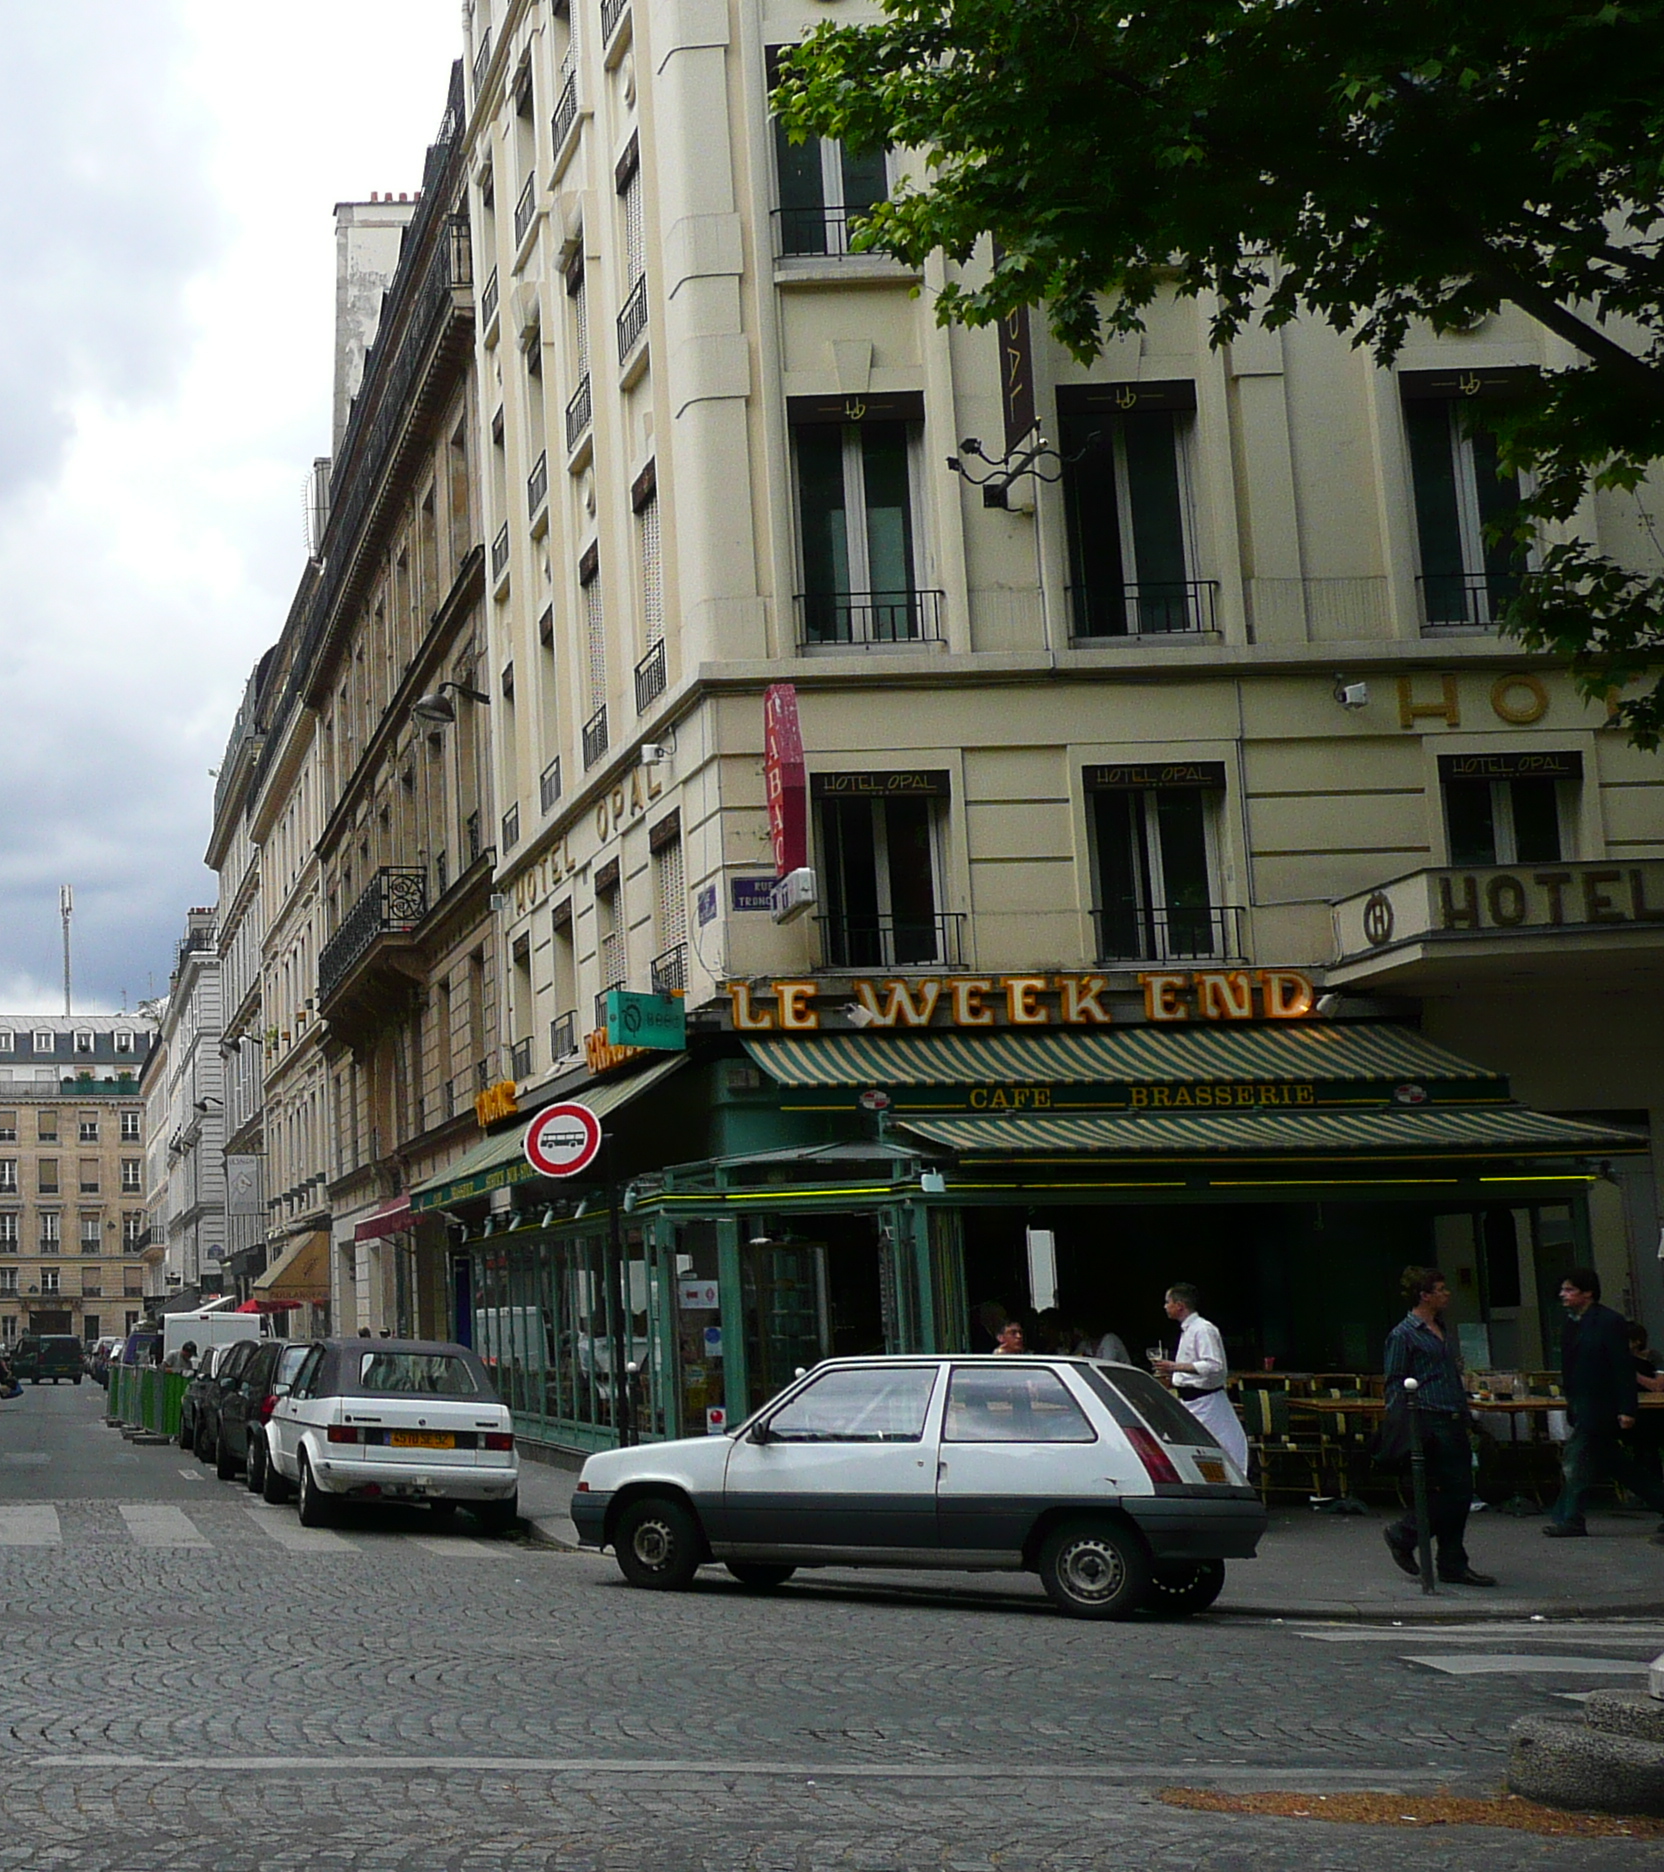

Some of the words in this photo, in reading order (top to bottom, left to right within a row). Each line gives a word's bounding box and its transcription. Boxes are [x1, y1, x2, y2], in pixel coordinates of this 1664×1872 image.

[1097, 767, 1157, 783] HOTEL
[1161, 766, 1212, 781] OPAL
[1453, 756, 1514, 774] HOTEL
[1518, 755, 1569, 771] OPAL
[766, 694, 785, 868] TABAC
[824, 774, 884, 791] HOTEL
[887, 774, 938, 790] OPAL
[515, 834, 576, 917] HOTEL
[596, 765, 662, 843] OPAL
[754, 881, 774, 892] RUE
[1439, 868, 1664, 930] HOTEL
[726, 982, 819, 1031] LE
[856, 974, 1113, 1029] WEEK
[1137, 969, 1315, 1023] END
[969, 1087, 1052, 1109] CAFE
[1128, 1084, 1316, 1107] BRASSERIE
